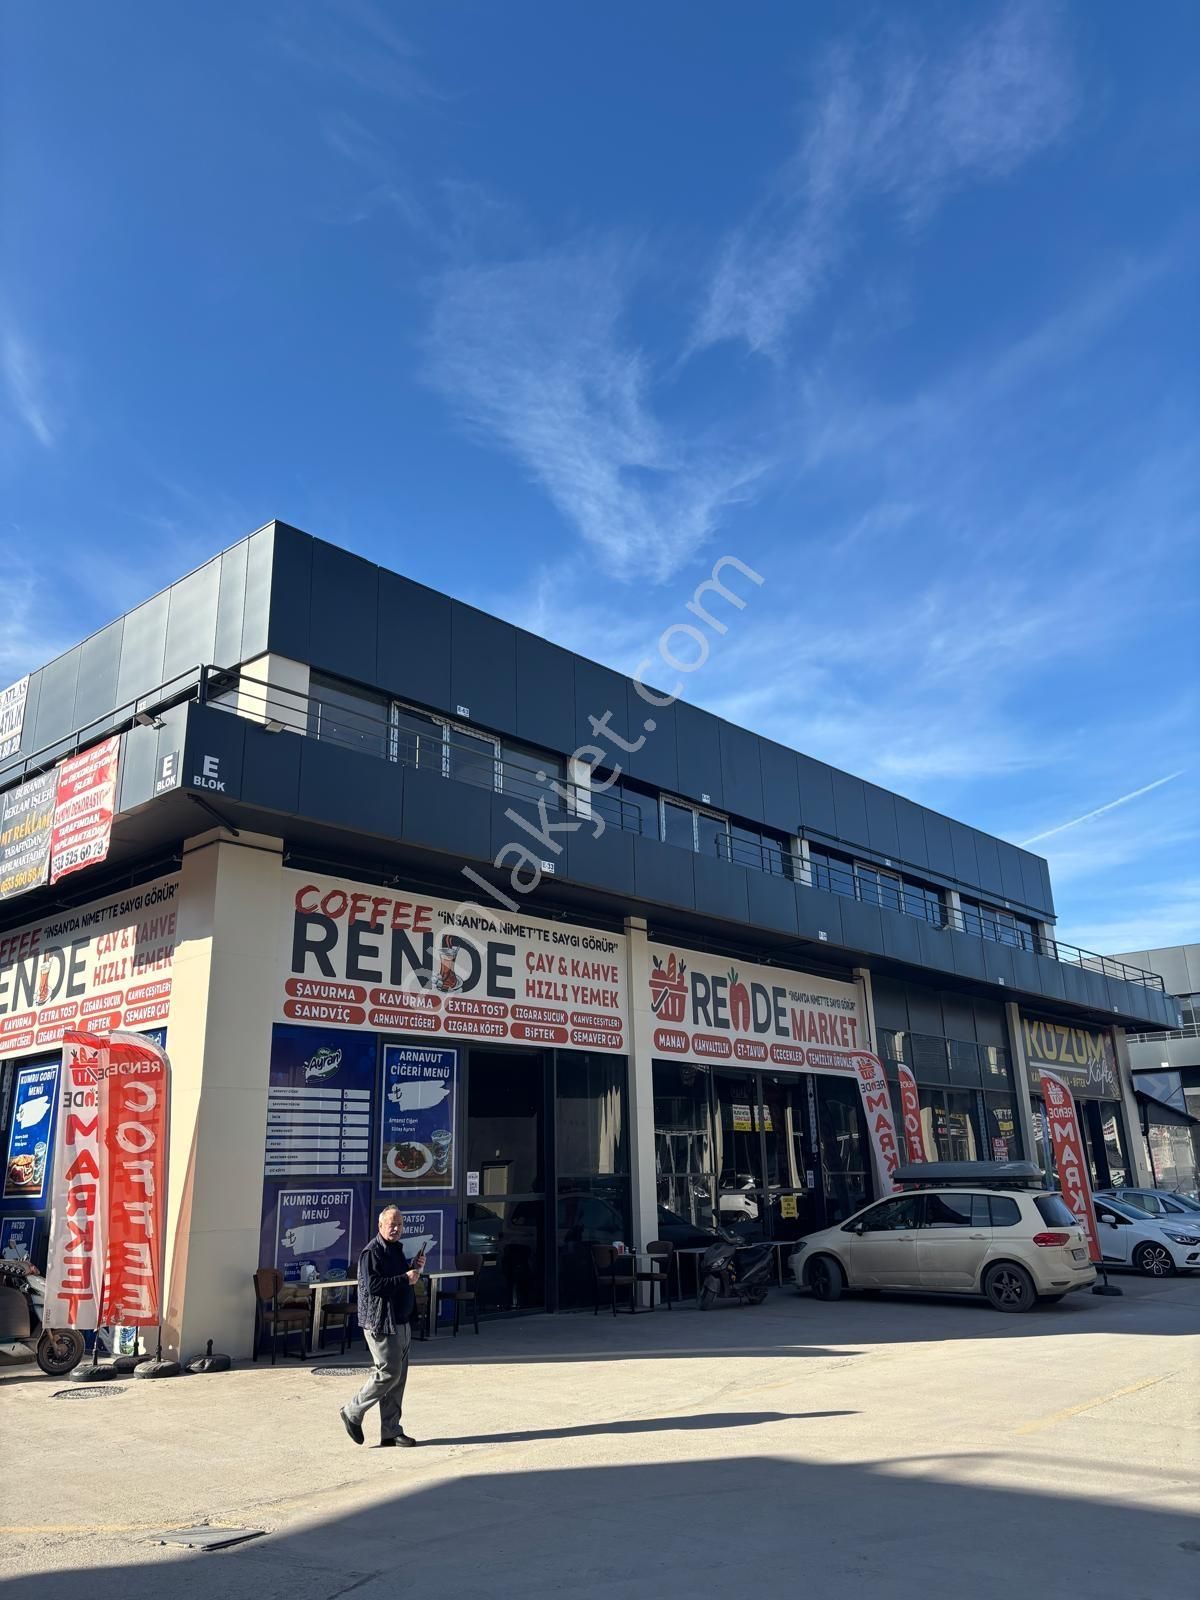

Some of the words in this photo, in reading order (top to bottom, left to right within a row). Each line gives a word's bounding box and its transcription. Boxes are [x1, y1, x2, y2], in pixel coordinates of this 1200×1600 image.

[162, 754, 174, 778] E
[203, 754, 219, 779] E
[156, 774, 177, 791] BLOK
[193, 775, 226, 792] BLOK
[119, 895, 143, 915] SAYGI
[295, 884, 433, 934] COFFEE
[96, 929, 119, 960] ÇAY
[132, 911, 176, 947] KAHVE
[551, 931, 580, 948] SAYGI
[291, 909, 516, 1000] RENDE
[93, 957, 126, 987] HIZLI
[130, 944, 174, 978] YEMEK
[525, 951, 555, 975] ÇAY
[557, 956, 569, 978] &
[571, 958, 619, 984] KAHVE
[128, 988, 146, 1001] KAHVE
[296, 982, 356, 1001] ŞAVURMA
[525, 978, 568, 1003] HIZLI
[570, 985, 620, 1009] YEMEK
[83, 997, 103, 1013] IZGARA
[379, 991, 434, 1010] KAVURMA
[448, 1000, 480, 1014] EXTRA
[481, 1003, 505, 1017] TOST
[40, 1008, 59, 1023] EXTRA
[60, 1004, 77, 1018] TOST
[126, 1006, 156, 1023] SEMAVER
[156, 1002, 171, 1019] ÇAY
[294, 1003, 351, 1023] SANDVİÇ
[373, 1012, 409, 1027] ARNAVUT
[409, 1014, 436, 1030] CİĞERİ
[515, 1007, 542, 1021] IZGARA
[543, 1010, 565, 1024] SUCUK
[573, 1014, 593, 1025] KAHVE
[3, 1016, 32, 1031] KAVURMA
[448, 1019, 478, 1033] IZGARA
[479, 1021, 505, 1036] KÖFTE
[790, 1007, 857, 1049] MARKET
[573, 1031, 606, 1044] SEMAVER
[607, 1034, 621, 1047] ÇAY
[658, 1033, 686, 1049] MANAV
[694, 1038, 730, 1055] KAHVALTILIK
[399, 1050, 443, 1064] ARNAVUT
[737, 1043, 765, 1060] ET-TAVUK
[390, 1062, 422, 1077] CİĞERİ
[422, 1065, 450, 1079] MENÜ
[282, 1194, 319, 1207] KUMRU
[320, 1191, 349, 1206] GOBİT
[301, 1208, 330, 1220] MENÜ
